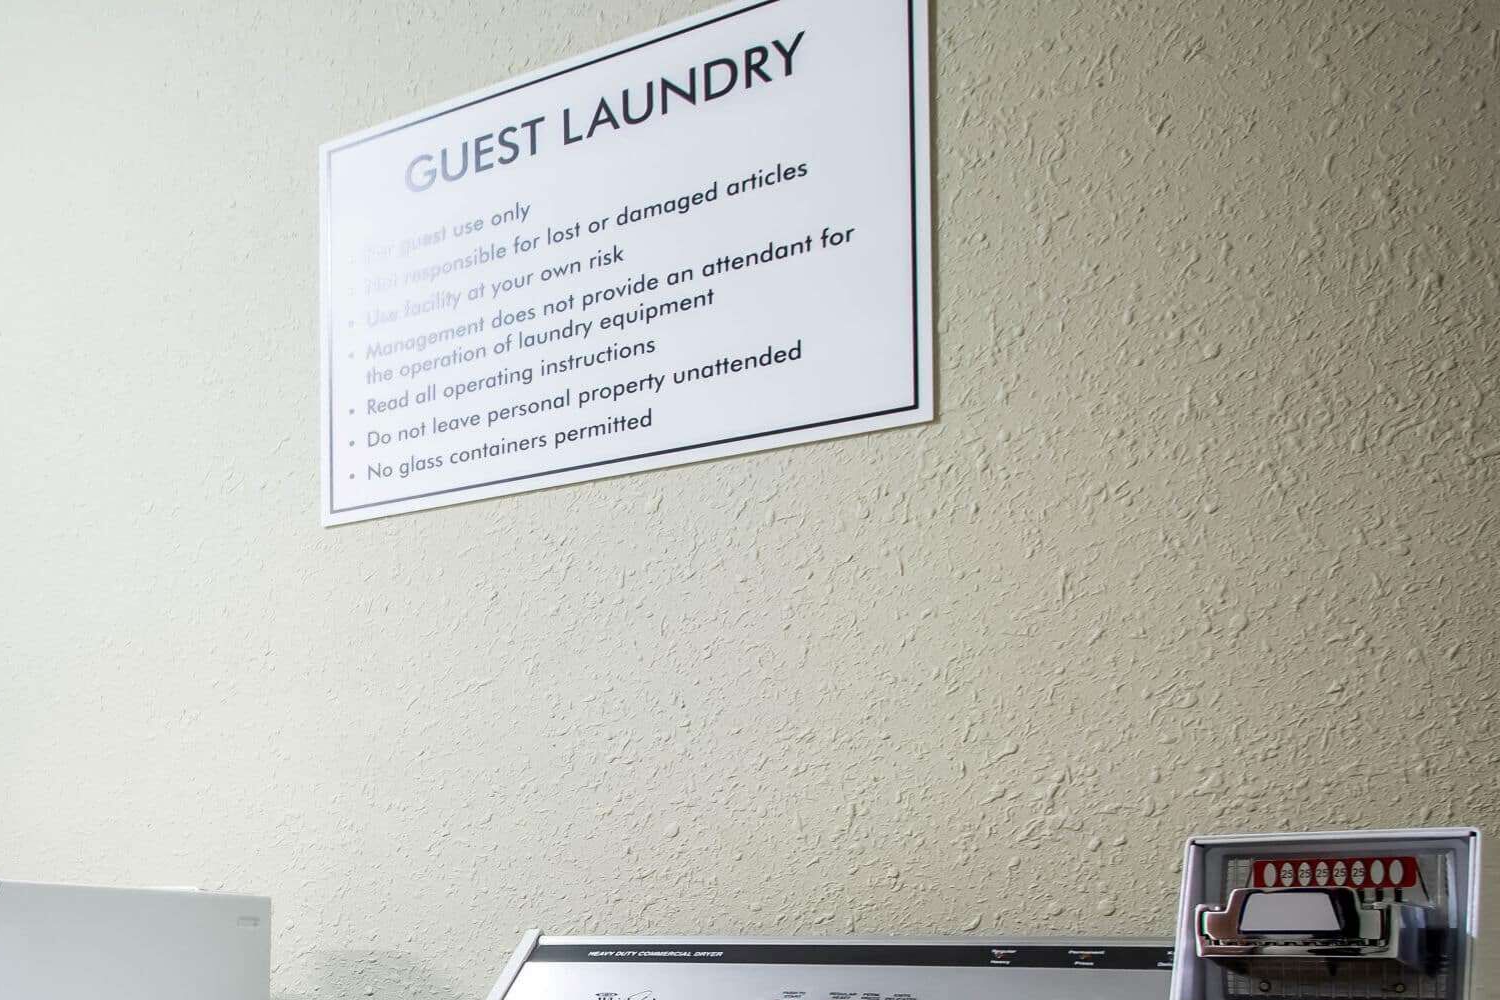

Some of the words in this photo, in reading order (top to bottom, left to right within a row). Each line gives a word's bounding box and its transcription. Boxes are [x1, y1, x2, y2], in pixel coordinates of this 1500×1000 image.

[403, 115, 546, 193] GUEST
[562, 30, 806, 146] LAUNDRY
[404, 243, 507, 284] responsible
[514, 234, 541, 254] for
[546, 221, 581, 246] lost
[588, 214, 611, 234] or
[616, 181, 719, 226] damaged
[726, 162, 808, 197] articles
[453, 217, 484, 238] use
[490, 201, 531, 226] only
[365, 317, 486, 361] Management
[491, 308, 537, 330] does
[543, 294, 576, 317] not
[582, 274, 660, 311] provide
[666, 266, 694, 286] an
[702, 235, 814, 279] attendant
[820, 225, 856, 250] for
[467, 282, 486, 302] at
[490, 271, 535, 299] your
[540, 259, 582, 283] own
[588, 244, 625, 271] risk
[366, 366, 394, 386] the
[399, 346, 487, 379] operation
[493, 333, 514, 356] of
[518, 318, 594, 350] laundry
[599, 288, 716, 331] equipment
[367, 389, 410, 416] Read
[415, 383, 437, 406] all
[442, 367, 534, 400] operating
[540, 338, 657, 378] instructions
[367, 430, 392, 449] Do
[398, 420, 426, 442] not
[432, 412, 482, 435] leave
[487, 387, 572, 428] personal
[578, 371, 667, 411] property
[672, 339, 804, 385] unattended
[367, 461, 394, 481] No
[399, 453, 445, 479] glass
[449, 434, 548, 465] containers
[553, 408, 654, 449] permitted
[1281, 868, 1293, 879] 25
[1299, 868, 1312, 878] 25
[1316, 867, 1329, 878] 25
[1334, 867, 1346, 878] 25
